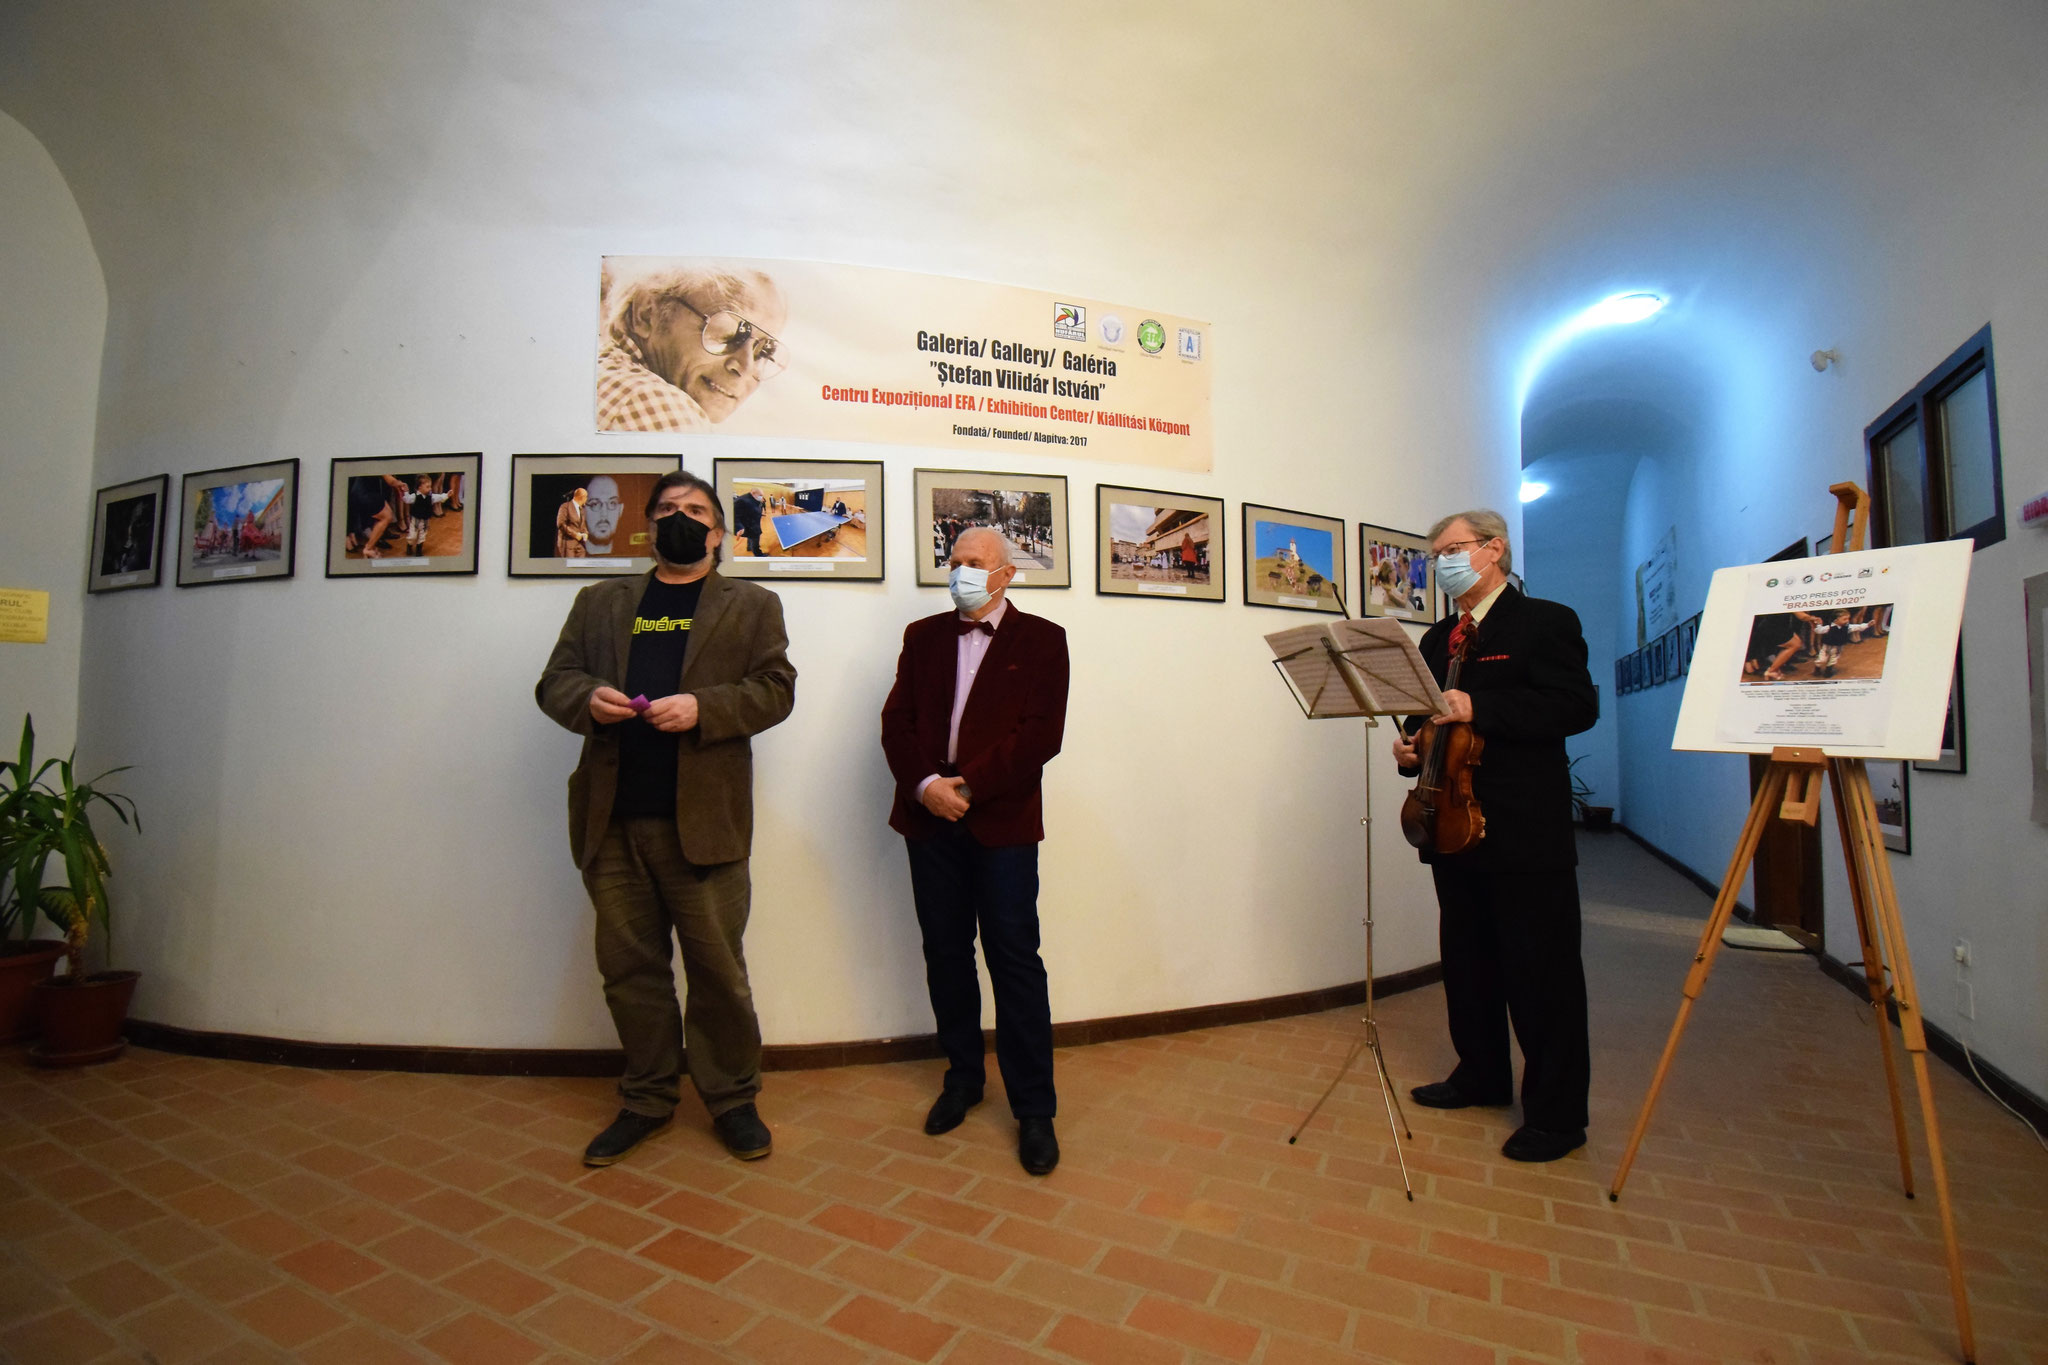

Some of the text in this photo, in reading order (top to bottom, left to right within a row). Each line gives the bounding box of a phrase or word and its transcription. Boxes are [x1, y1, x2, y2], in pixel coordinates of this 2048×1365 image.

[917, 330, 1117, 377] Galeria/ Gallery/ Galéria
[995, 368, 1049, 394] Vilidár
[822, 385, 1191, 437] Centru Expozițional EFA / Exhibition Center/ Kiállítási Központ
[952, 424, 991, 438] Fondată/
[993, 428, 1032, 442] Founded/
[1070, 435, 1088, 446] 2017
[1810, 590, 1839, 599] PRESS
[1841, 588, 1867, 596] FOTO
